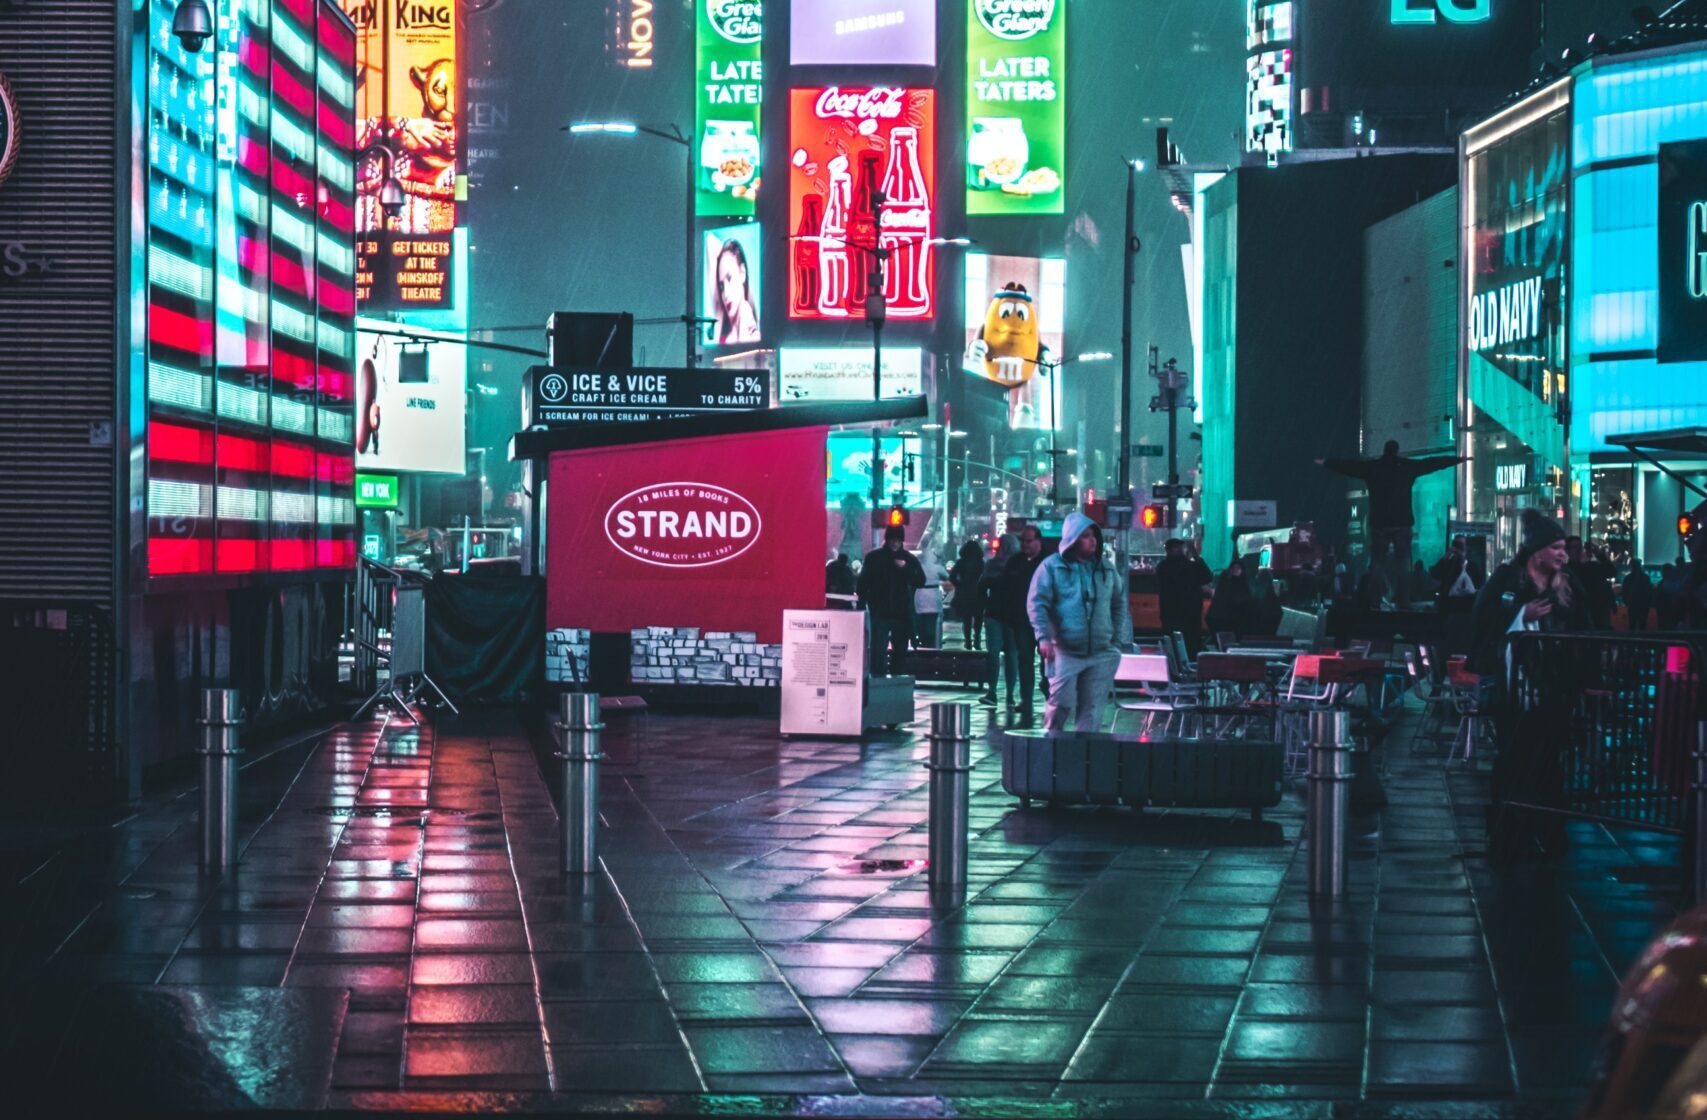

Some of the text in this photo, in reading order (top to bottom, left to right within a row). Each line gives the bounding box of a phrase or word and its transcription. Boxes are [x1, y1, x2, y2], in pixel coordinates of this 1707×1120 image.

[396, 0, 450, 29] KING
[835, 10, 905, 35] SAMSUNG
[628, 0, 653, 67] NOV
[710, 60, 762, 81] LATE
[978, 56, 1051, 78] LATER
[973, 80, 1057, 102] TATERS
[392, 241, 450, 256] GET TICKETS
[404, 256, 439, 270] AT THE
[396, 271, 446, 285] MINSKOFF
[401, 286, 442, 301] THEATRE
[1470, 275, 1542, 352] OLD NAVY
[572, 374, 667, 392] ICE & VICE
[734, 376, 762, 393] 5%
[571, 393, 667, 404] CRAFT ICE CREAM
[701, 395, 762, 405] TO CHARITY
[545, 412, 580, 421] SCREAM
[582, 412, 598, 421] FOR
[601, 412, 615, 421] ICE
[616, 412, 651, 422] CREAM!
[1496, 465, 1509, 490] OLD
[651, 489, 680, 499] MILES
[683, 489, 696, 497] OF
[699, 490, 729, 504] BOOKS
[616, 510, 752, 539] STRAND
[633, 544, 650, 555] NEW
[651, 550, 670, 559] YORK
